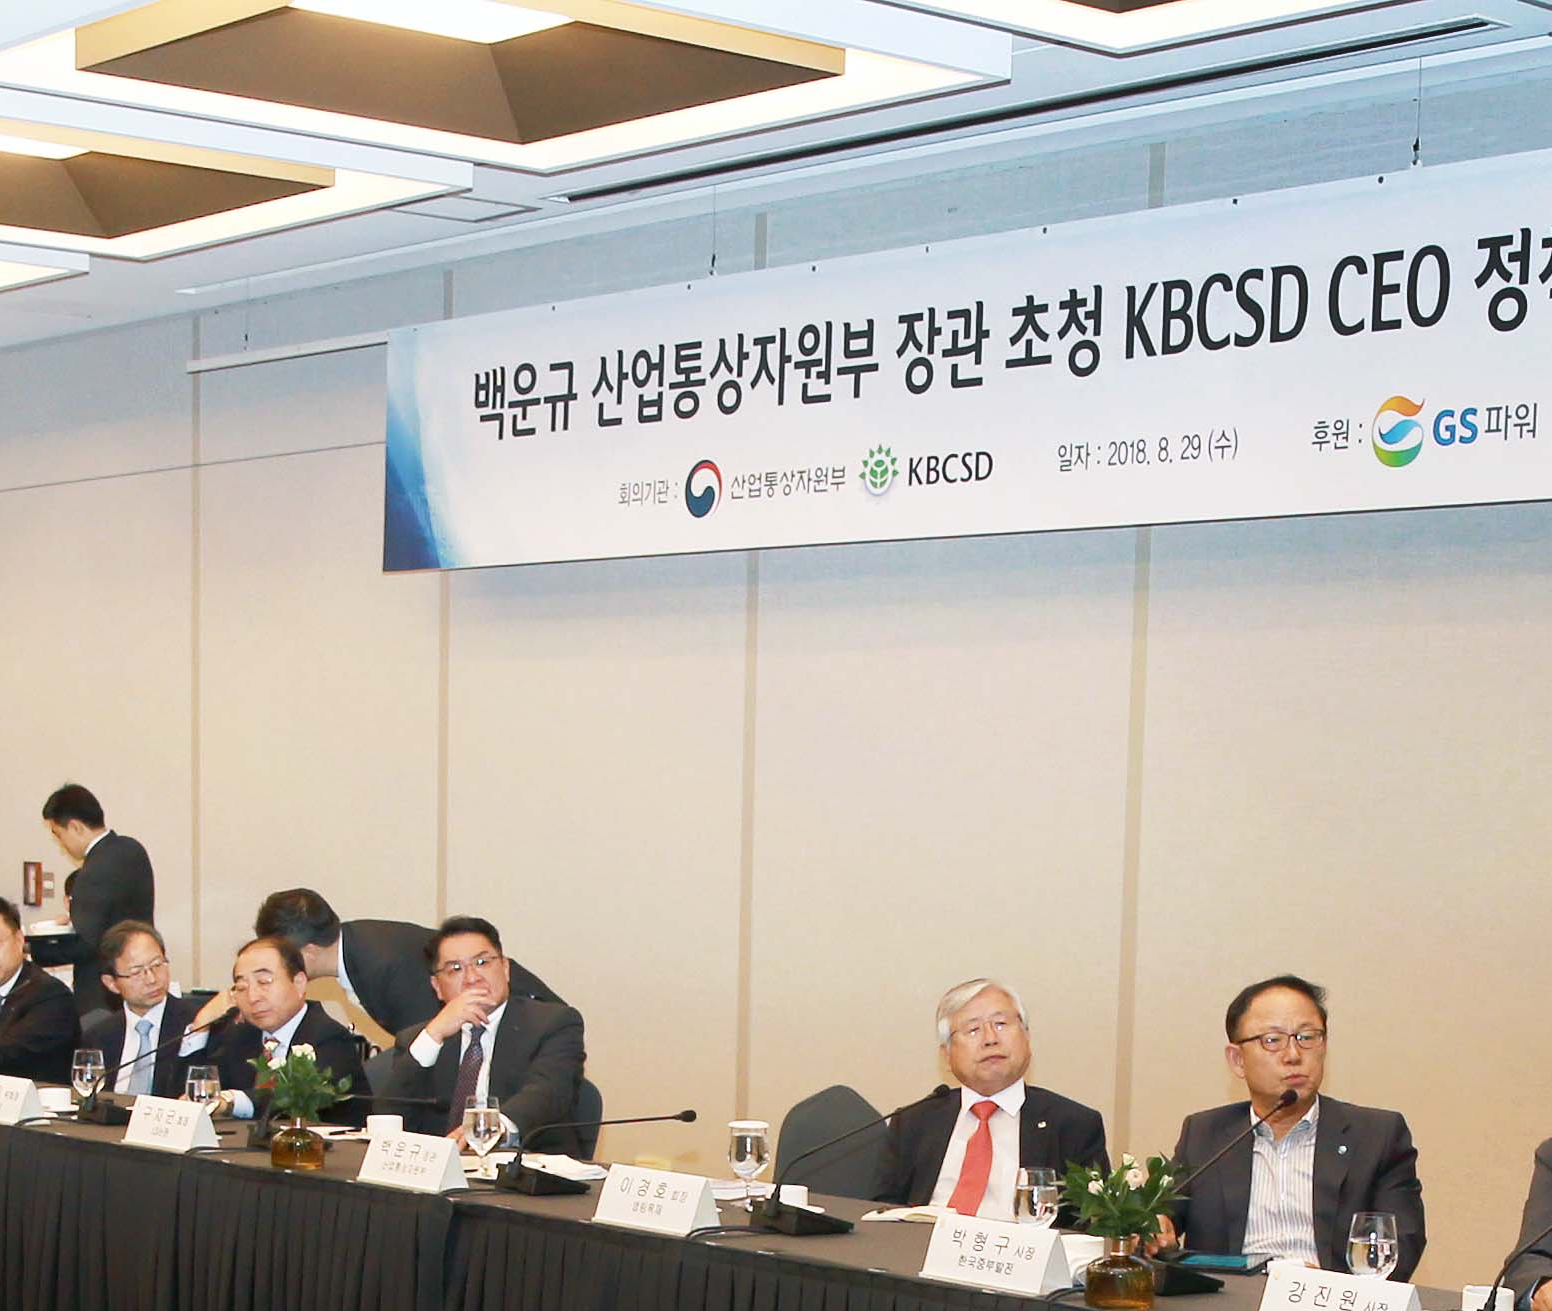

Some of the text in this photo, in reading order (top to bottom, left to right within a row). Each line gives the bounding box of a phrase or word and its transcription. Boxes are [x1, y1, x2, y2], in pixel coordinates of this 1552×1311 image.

[474, 360, 578, 441] 백운규
[591, 318, 880, 428] 산업통상자원부
[895, 300, 991, 395] 장관
[1005, 284, 1103, 378] 초청
[1125, 264, 1309, 360] KBCSD
[1328, 244, 1451, 337] CEO
[1057, 441, 1091, 473] 일자
[1180, 433, 1202, 461] 29
[1208, 427, 1238, 462] (수)
[1311, 418, 1350, 452] 후원
[1432, 407, 1479, 447] GS
[1484, 402, 1538, 441] 파워
[617, 479, 670, 507] 회의기관
[730, 465, 846, 500] 산업통상자원부
[908, 451, 994, 487] KBCSD
